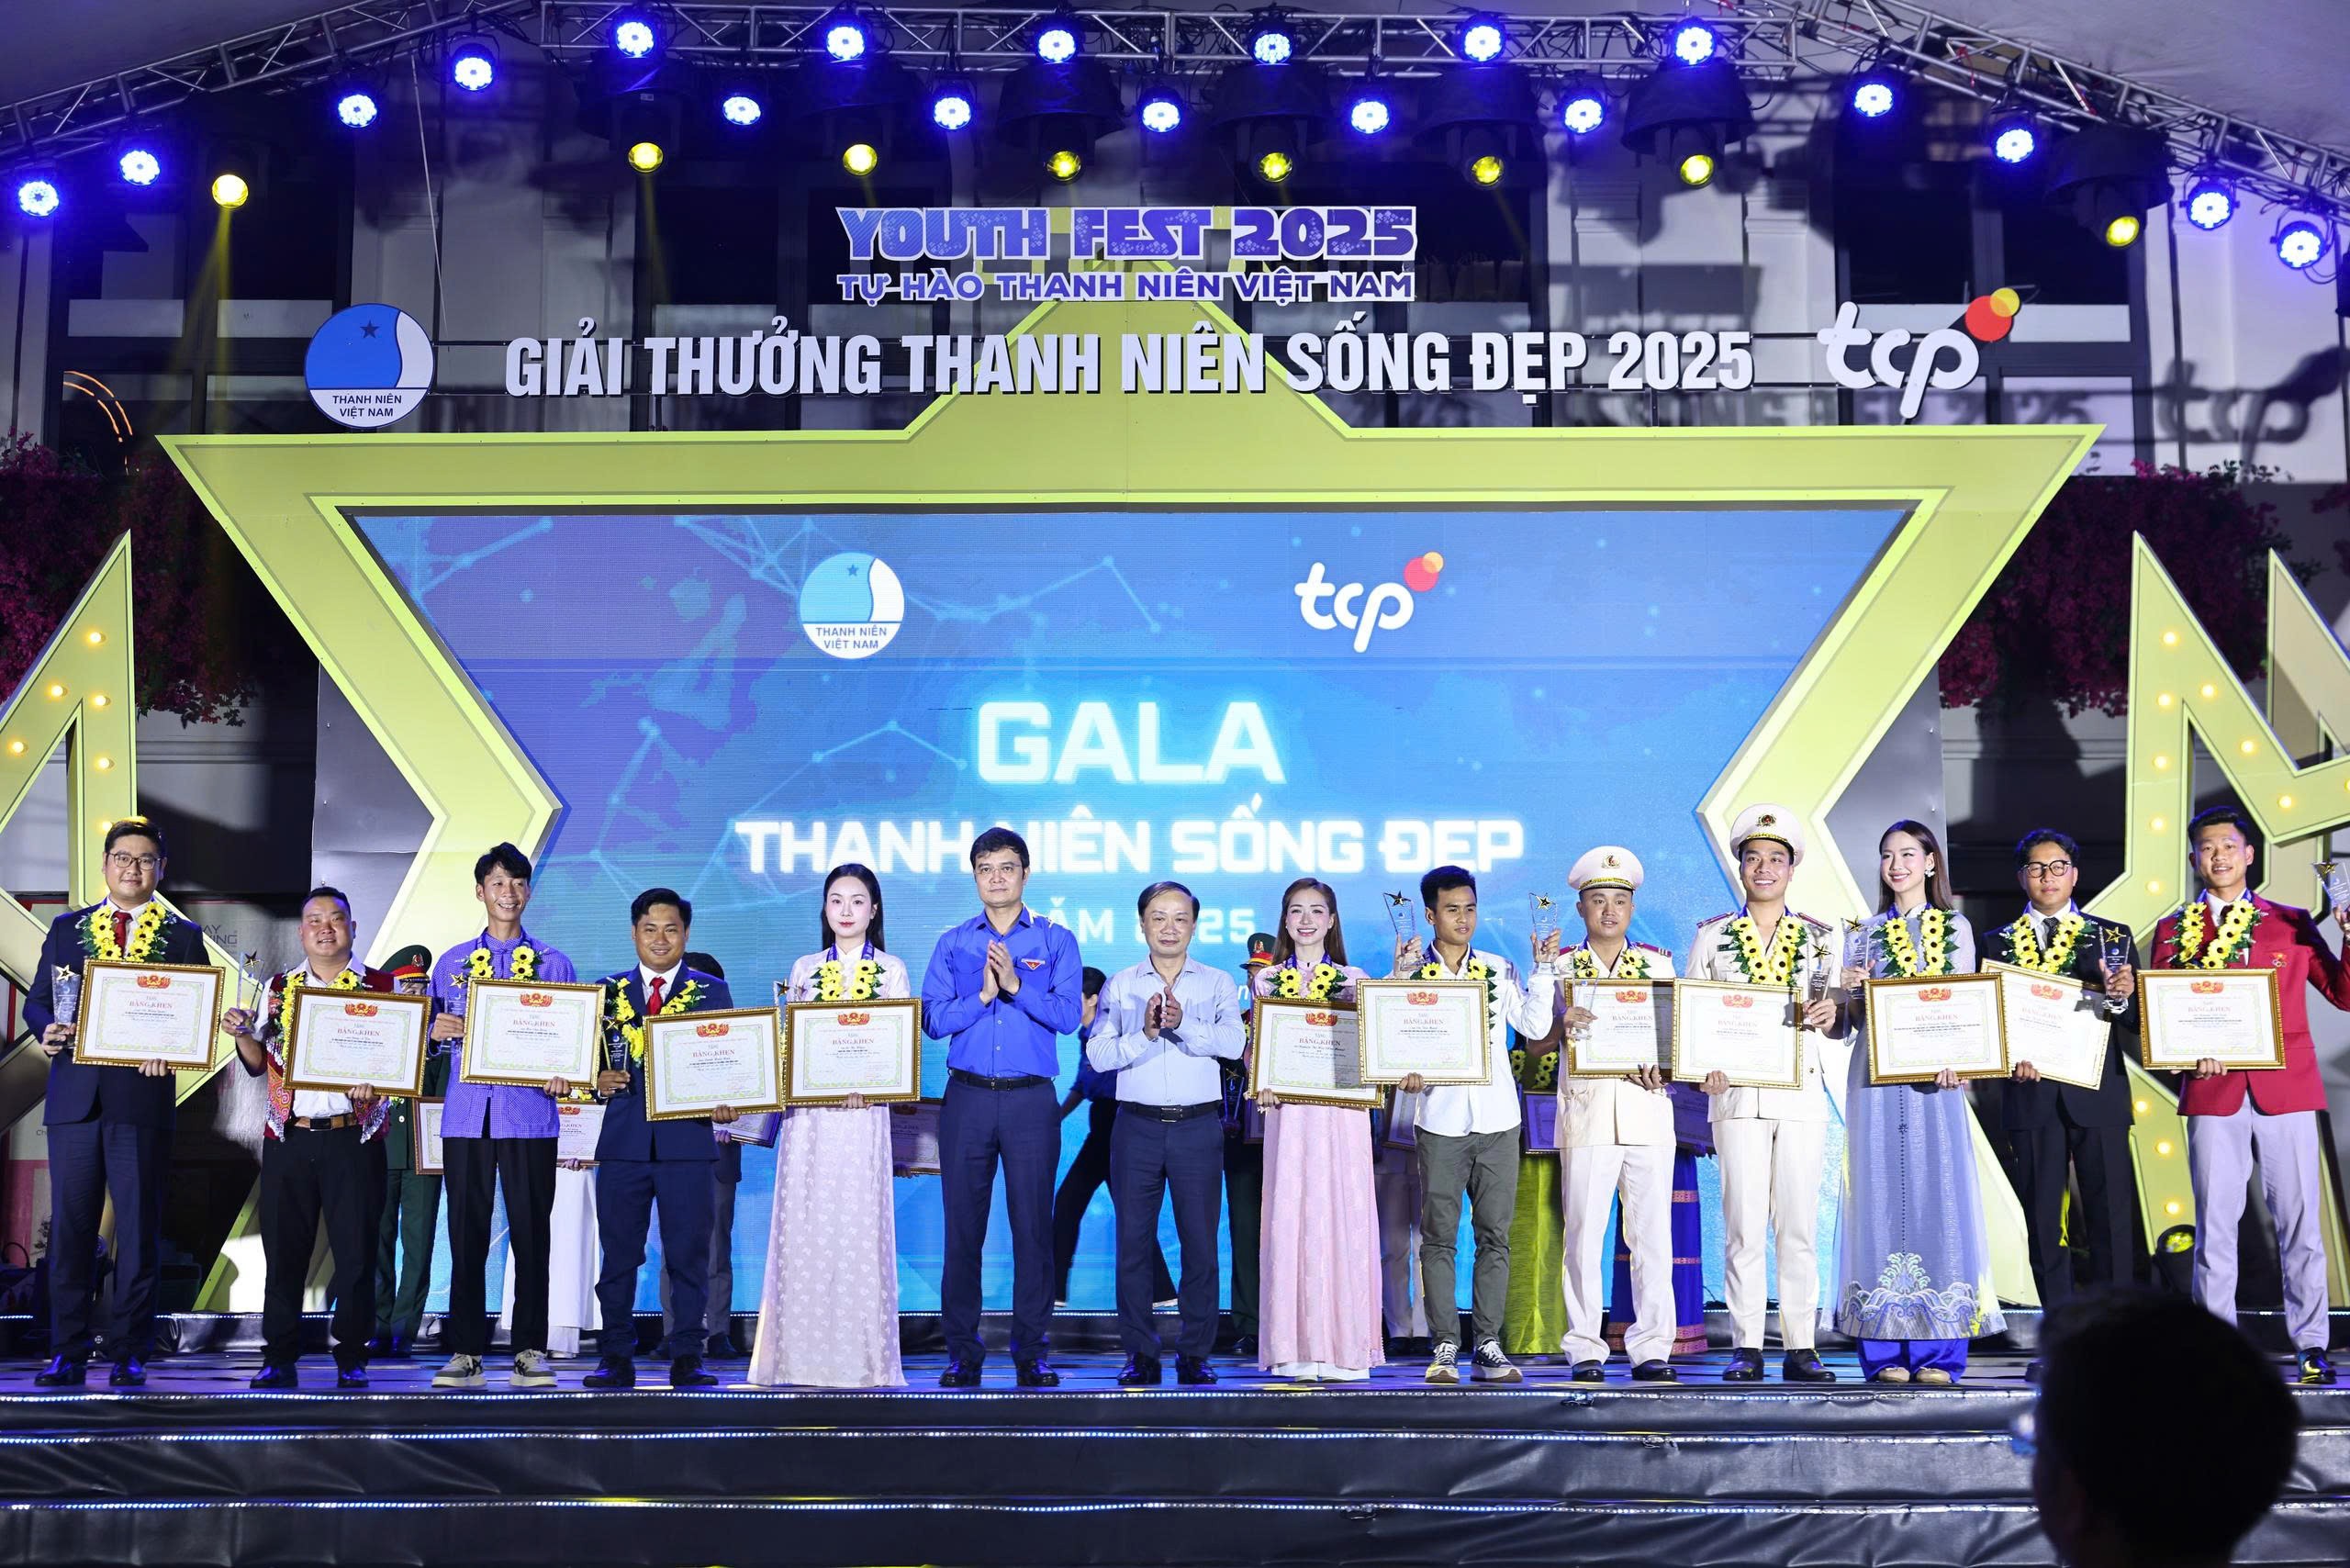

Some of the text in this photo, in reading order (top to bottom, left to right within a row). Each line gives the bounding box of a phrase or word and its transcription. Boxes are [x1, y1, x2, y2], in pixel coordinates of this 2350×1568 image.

[835, 206, 1417, 261] YOUTH FEST 2025
[901, 267, 985, 301] HÀO
[993, 272, 1125, 301] THANH
[1135, 265, 1224, 301] NIÊN
[1233, 265, 1315, 307] VIỆT
[1327, 271, 1415, 301] NAM
[505, 310, 1753, 404] GIẢI THƯỞNG THANH NIÊN SỐNG ĐẸP 2025
[1817, 301, 1981, 419] tcp
[332, 393, 402, 404] THANH NIÊN
[340, 406, 393, 419] VIỆT NAM
[815, 624, 887, 636] THANH NIÊN
[1294, 562, 1415, 653] tcp
[853, 640, 878, 649] NAM
[979, 701, 1285, 784] GALA
[735, 820, 975, 873] THANH
[1171, 793, 1364, 873] SỐNG
